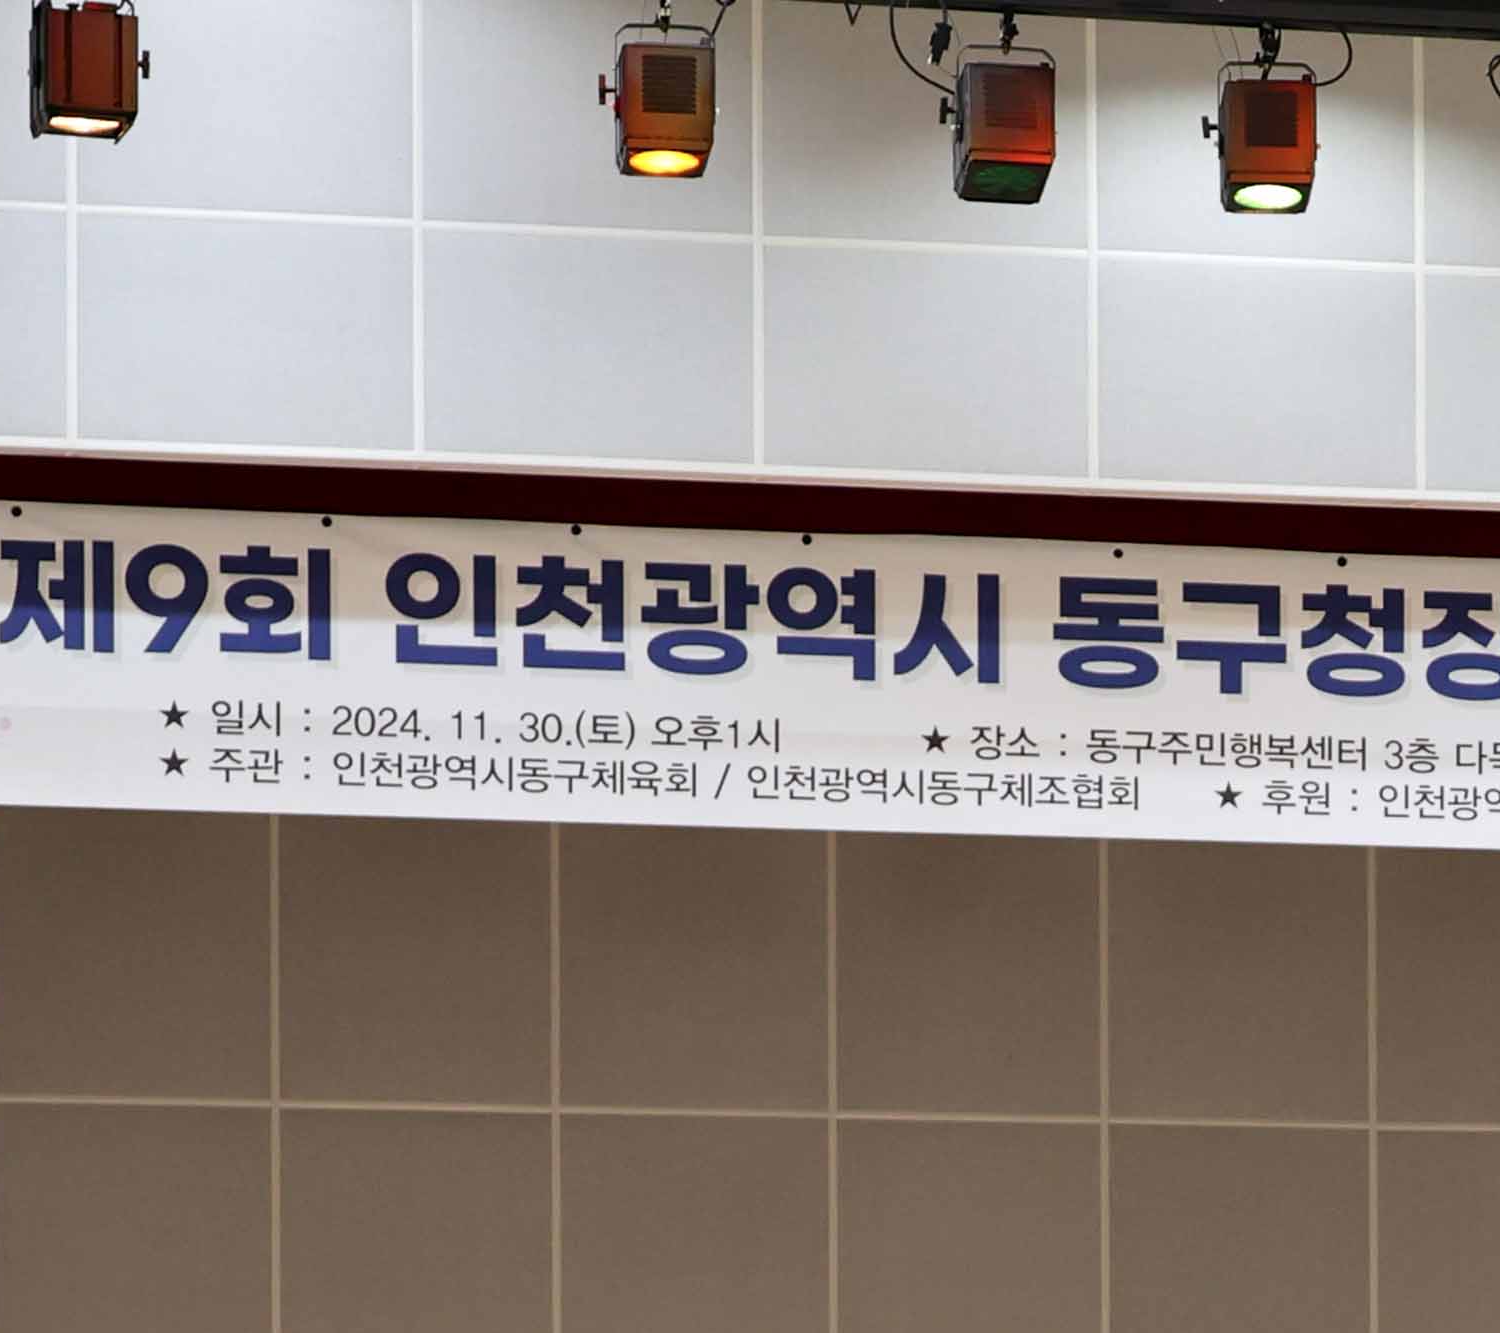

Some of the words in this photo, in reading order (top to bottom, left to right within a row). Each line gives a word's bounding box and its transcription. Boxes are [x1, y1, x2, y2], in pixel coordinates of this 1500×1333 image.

[0, 539, 332, 661] 제9회
[384, 552, 1000, 685] 인천광역시
[211, 700, 281, 737] 일시
[332, 705, 430, 741] 2024.
[452, 711, 501, 744] 11.
[519, 711, 635, 750] 30.(토)
[651, 715, 780, 753] 오후1시
[971, 725, 1040, 760] 장소
[1086, 729, 1366, 771] 동구주민행복센터
[1385, 738, 1439, 774] 3층
[210, 748, 283, 784] 주관
[333, 752, 697, 798] 인천광역시동구체육회
[747, 766, 1138, 810] 인천광역시동구체조협회
[1263, 780, 1329, 816] 후원
